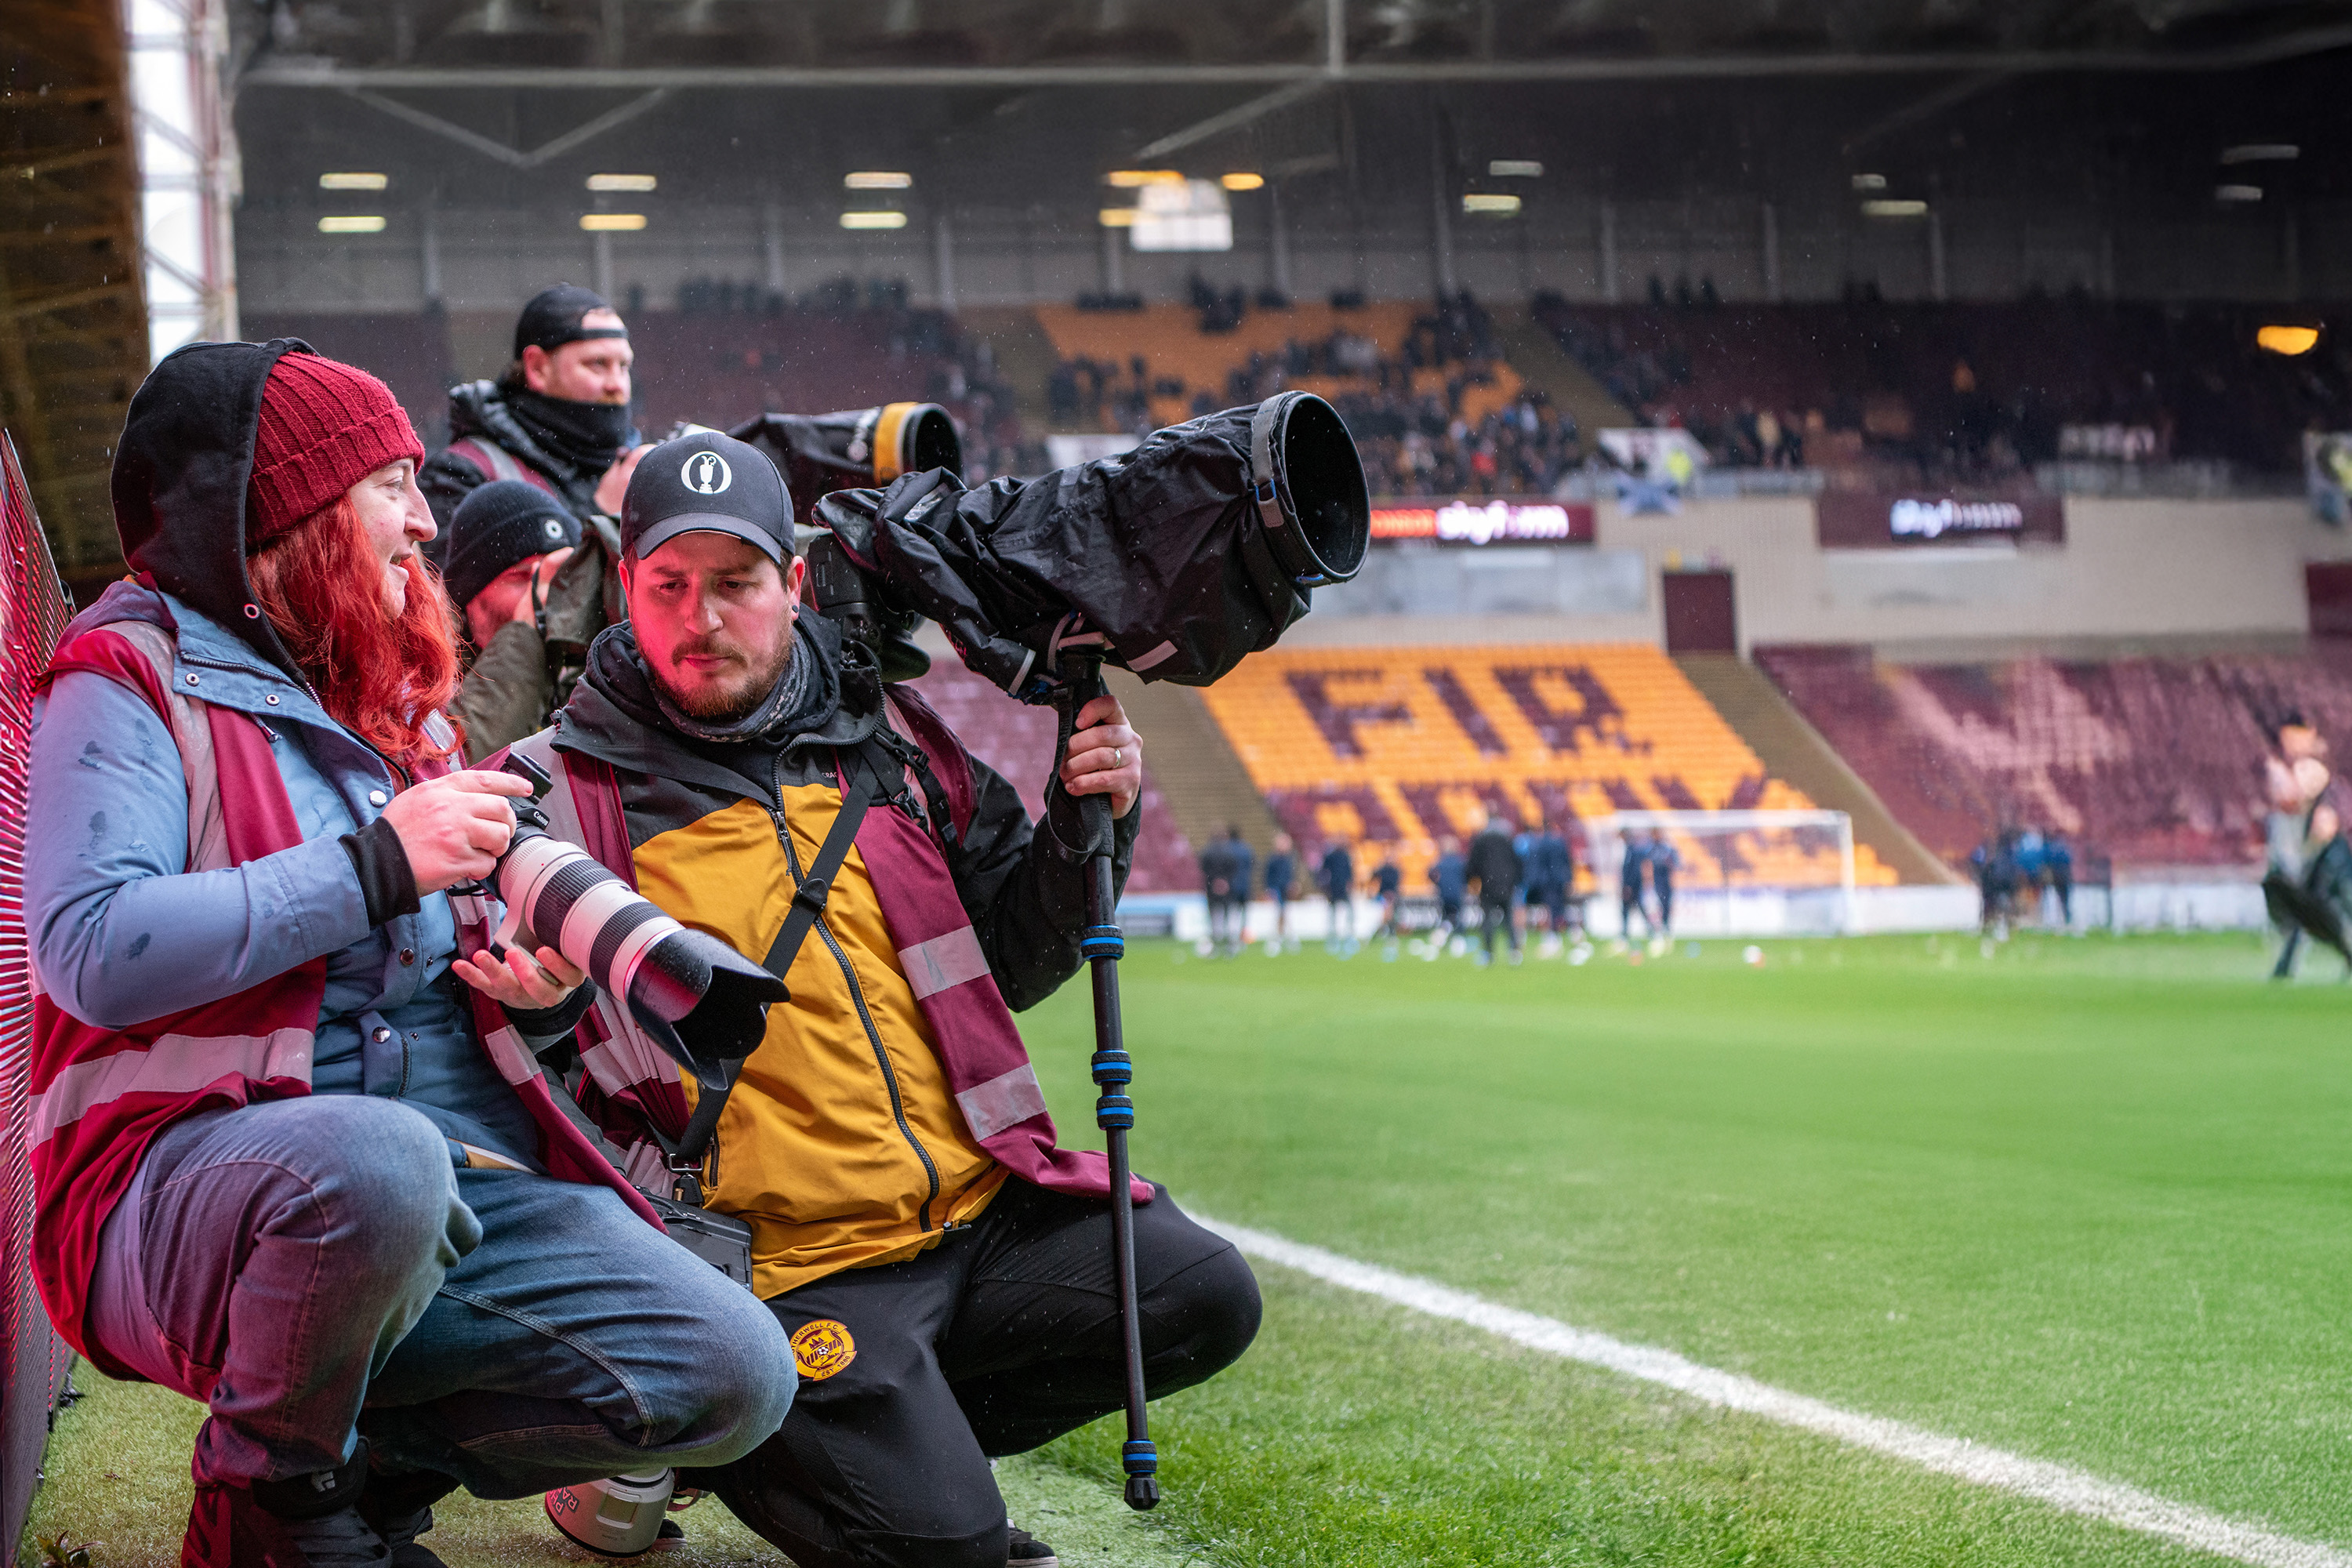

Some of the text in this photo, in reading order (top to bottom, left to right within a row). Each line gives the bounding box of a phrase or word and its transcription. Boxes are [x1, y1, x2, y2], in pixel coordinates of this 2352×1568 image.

[1283, 668, 1653, 759] FIR
[533, 811, 549, 826] Canon
[791, 1323, 823, 1353] OTHERWELL
[837, 1356, 851, 1368] 1886
